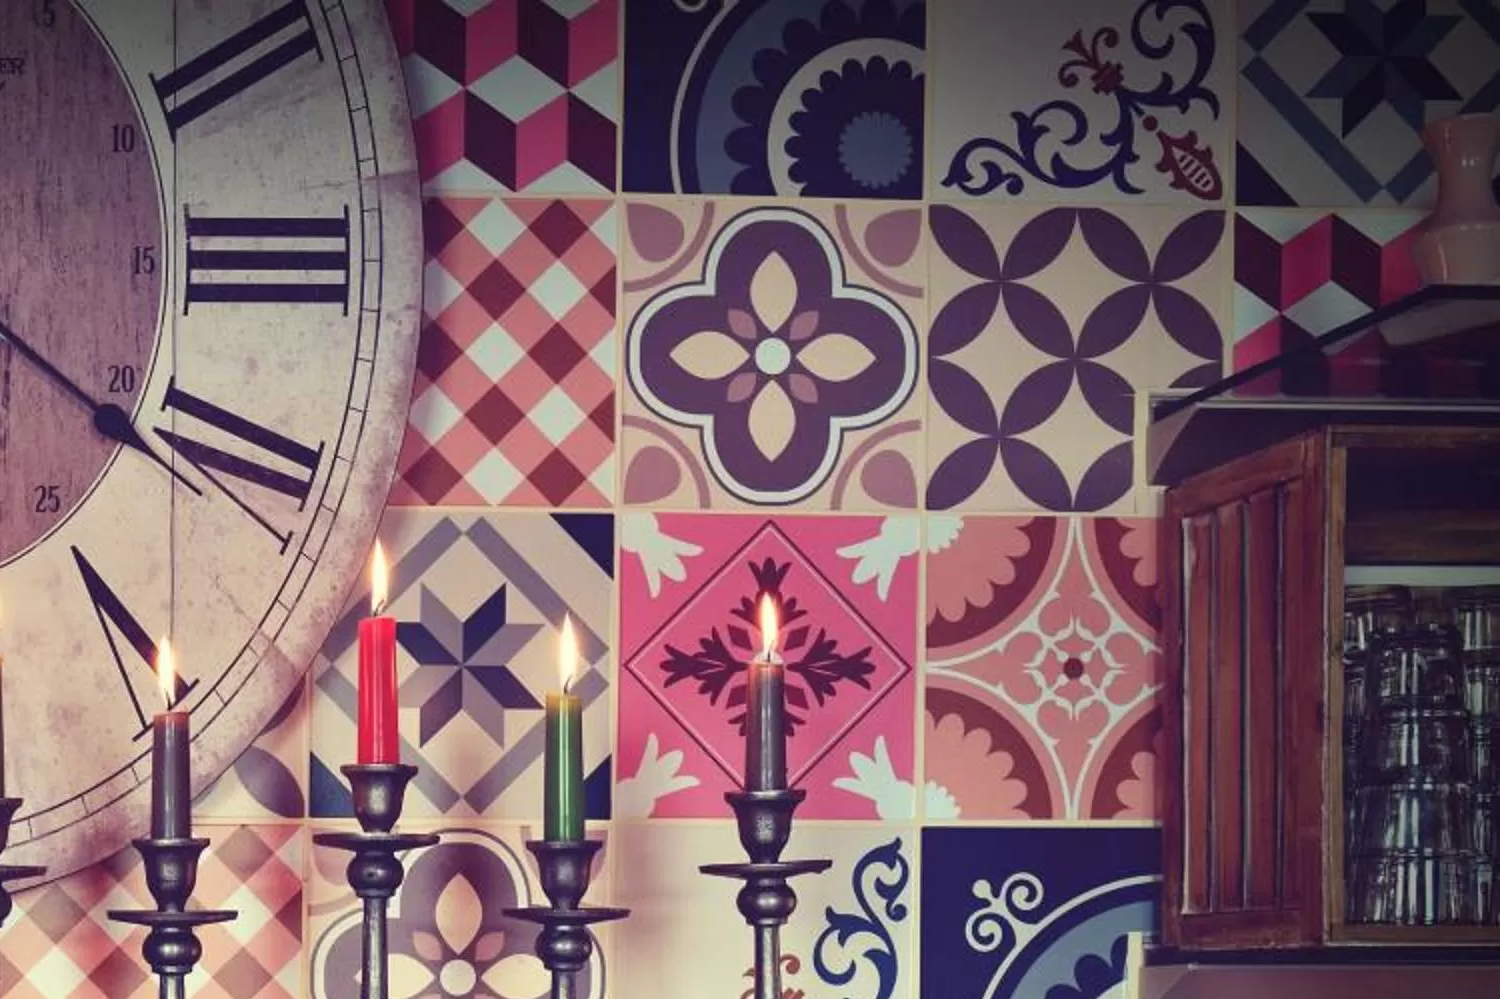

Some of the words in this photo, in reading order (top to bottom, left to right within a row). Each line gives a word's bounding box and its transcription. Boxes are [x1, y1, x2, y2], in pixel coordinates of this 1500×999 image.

[111, 124, 135, 153] 10
[131, 246, 155, 275] 15
[183, 203, 350, 317] III
[107, 365, 135, 393] 20
[34, 485, 61, 513] 25
